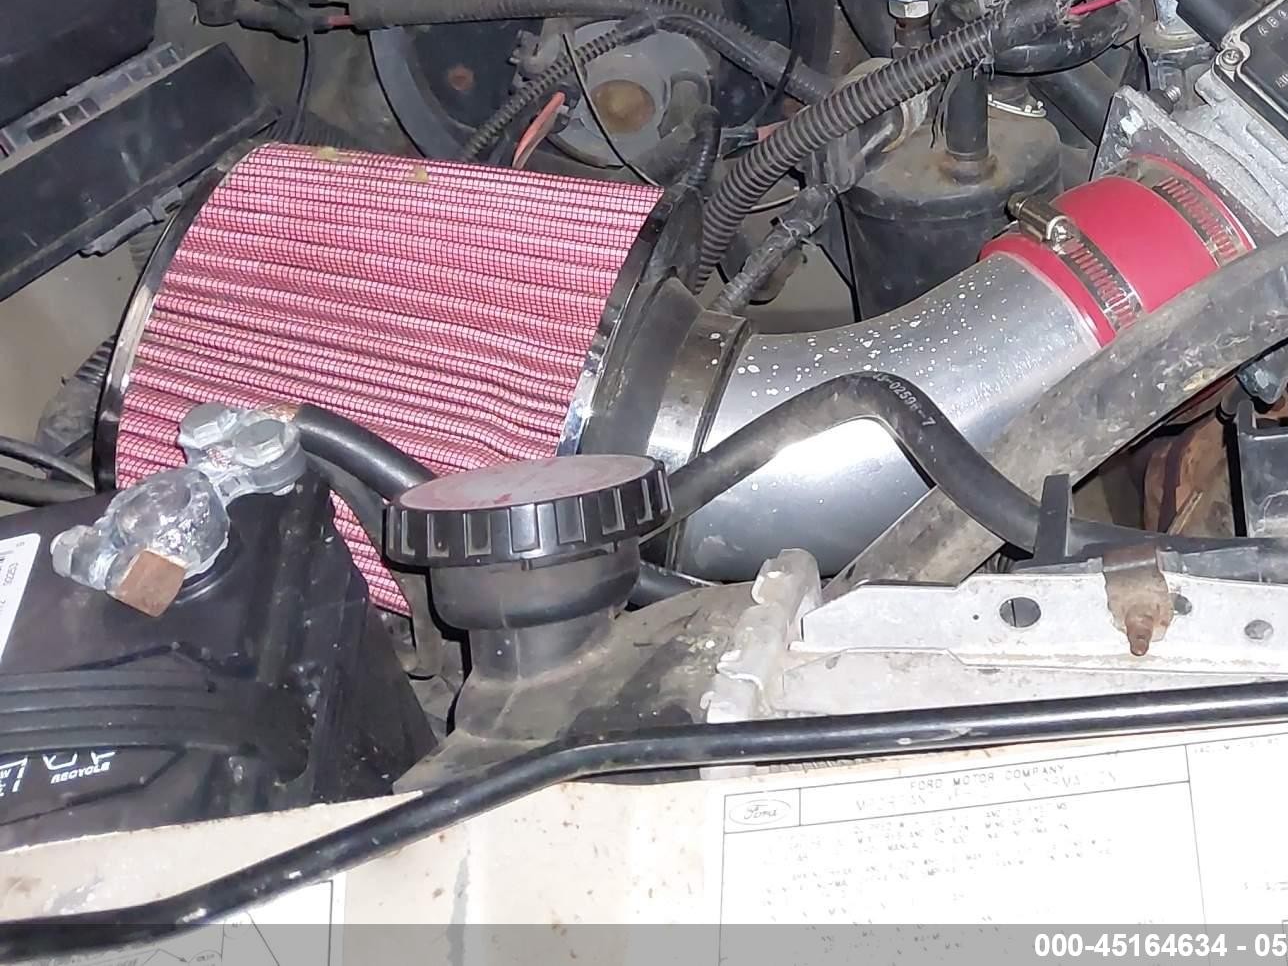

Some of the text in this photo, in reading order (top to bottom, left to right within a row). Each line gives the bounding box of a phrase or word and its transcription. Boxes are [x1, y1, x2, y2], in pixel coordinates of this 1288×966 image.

[50, 761, 110, 784] RECYCLE
[909, 762, 1065, 792] FORD MOTOR COMPANY
